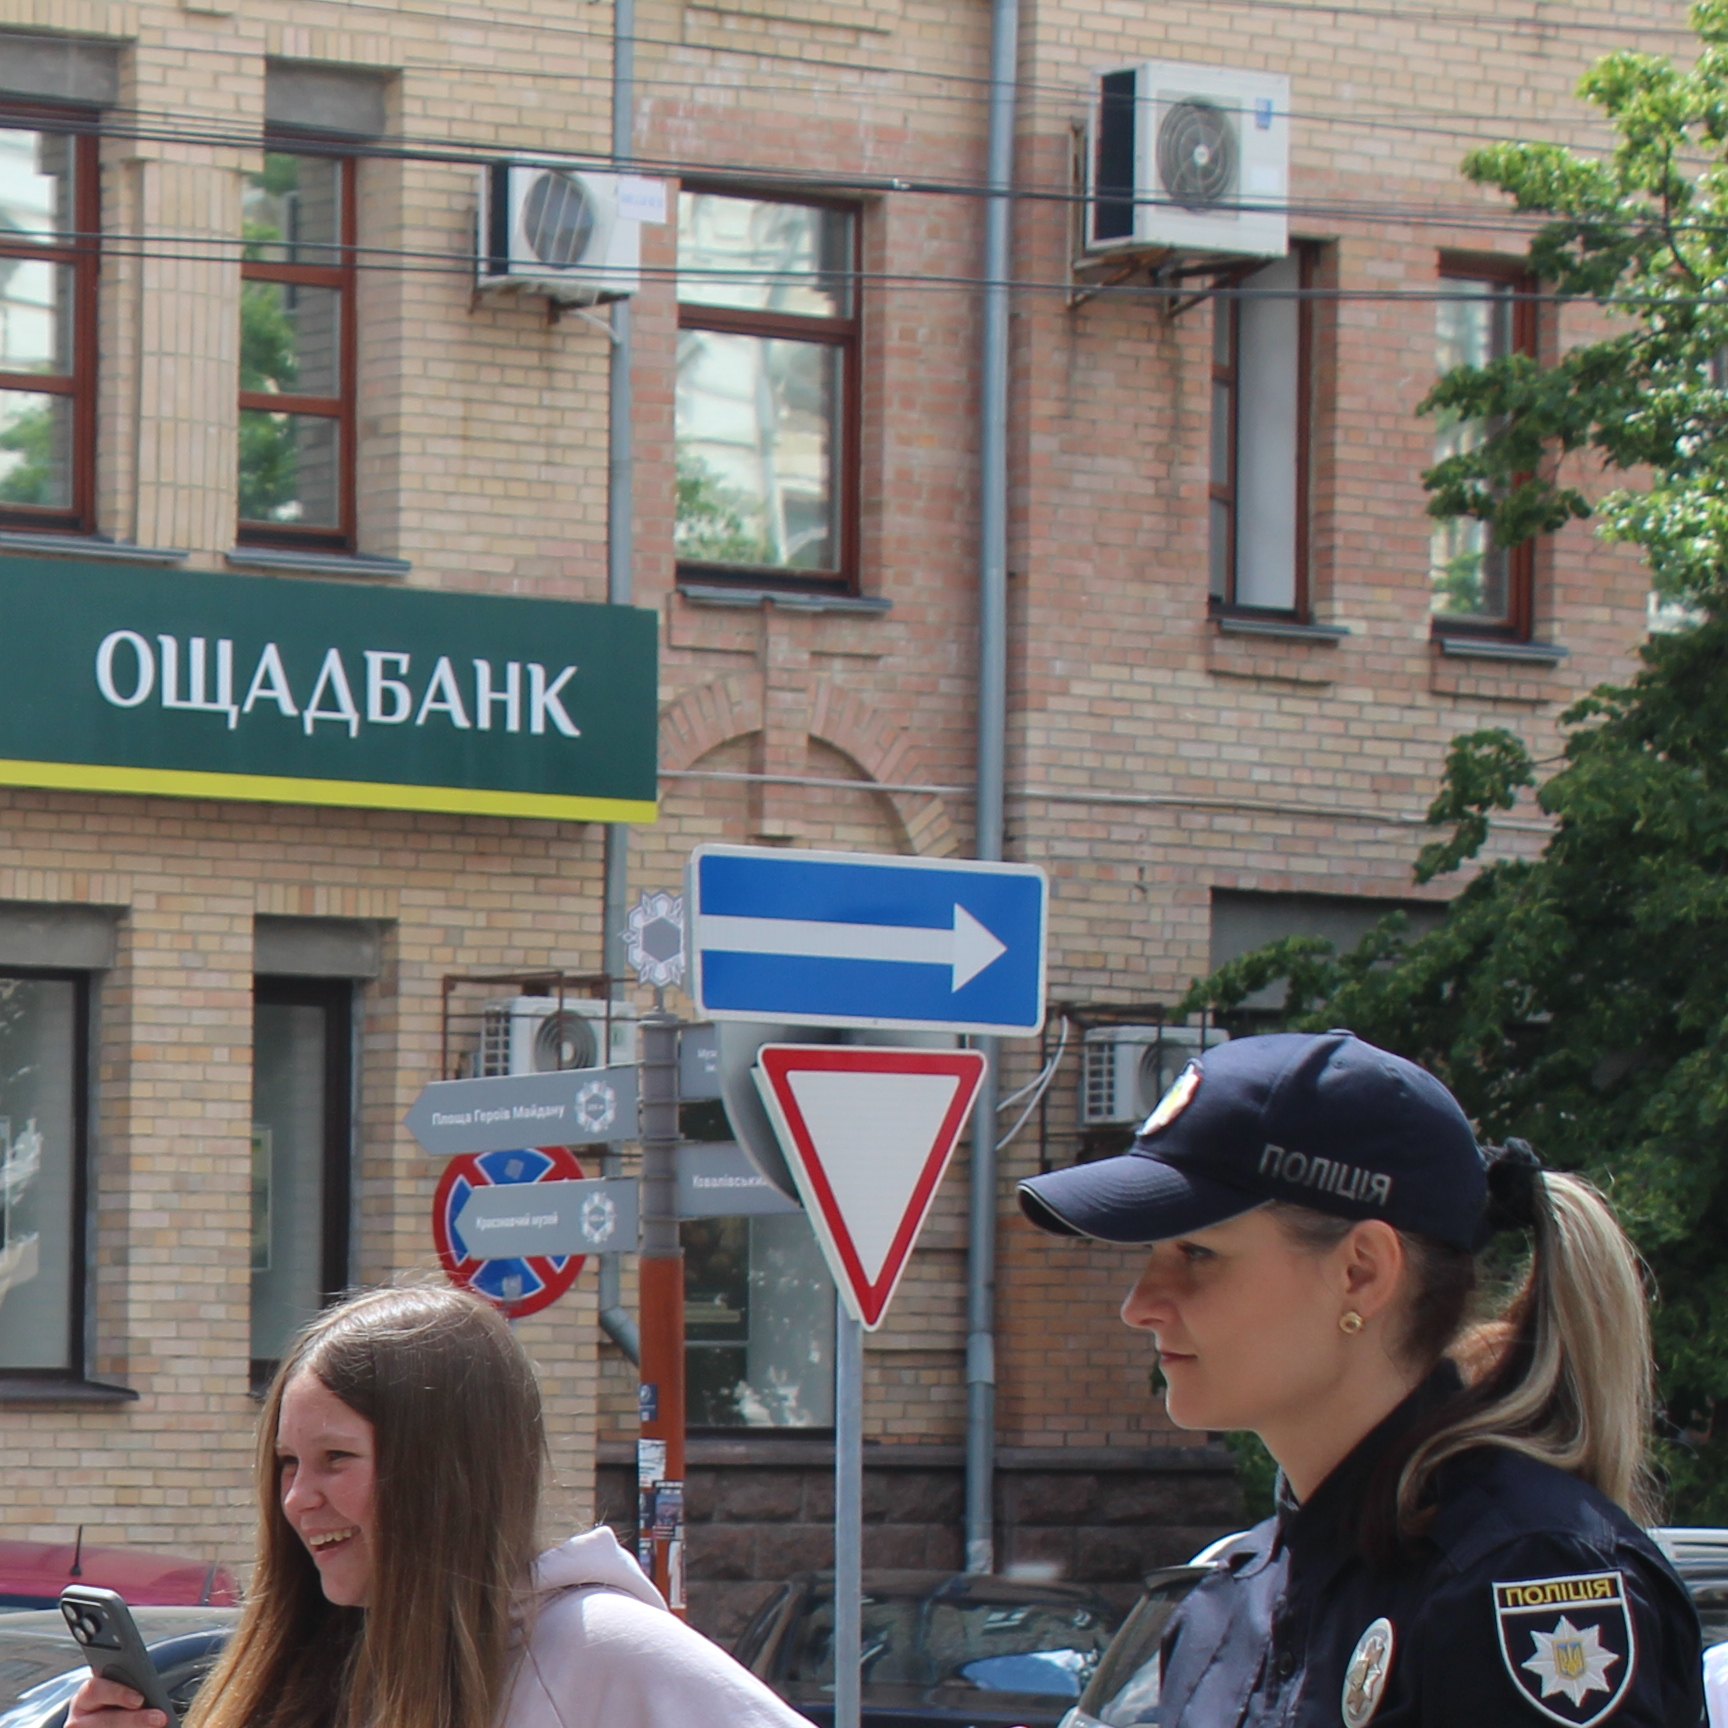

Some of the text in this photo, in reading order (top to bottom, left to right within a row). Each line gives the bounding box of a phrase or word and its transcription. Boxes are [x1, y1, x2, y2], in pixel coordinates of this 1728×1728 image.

[95, 629, 582, 738] ОЩАДБАНК
[432, 1103, 565, 1126] Площа Героїв Майдану
[692, 1174, 769, 1188] Ковалівськи
[1258, 1143, 1392, 1207] ПОЛІЦІЯ
[1505, 1578, 1613, 1608] ПОЛІЦІЯ
